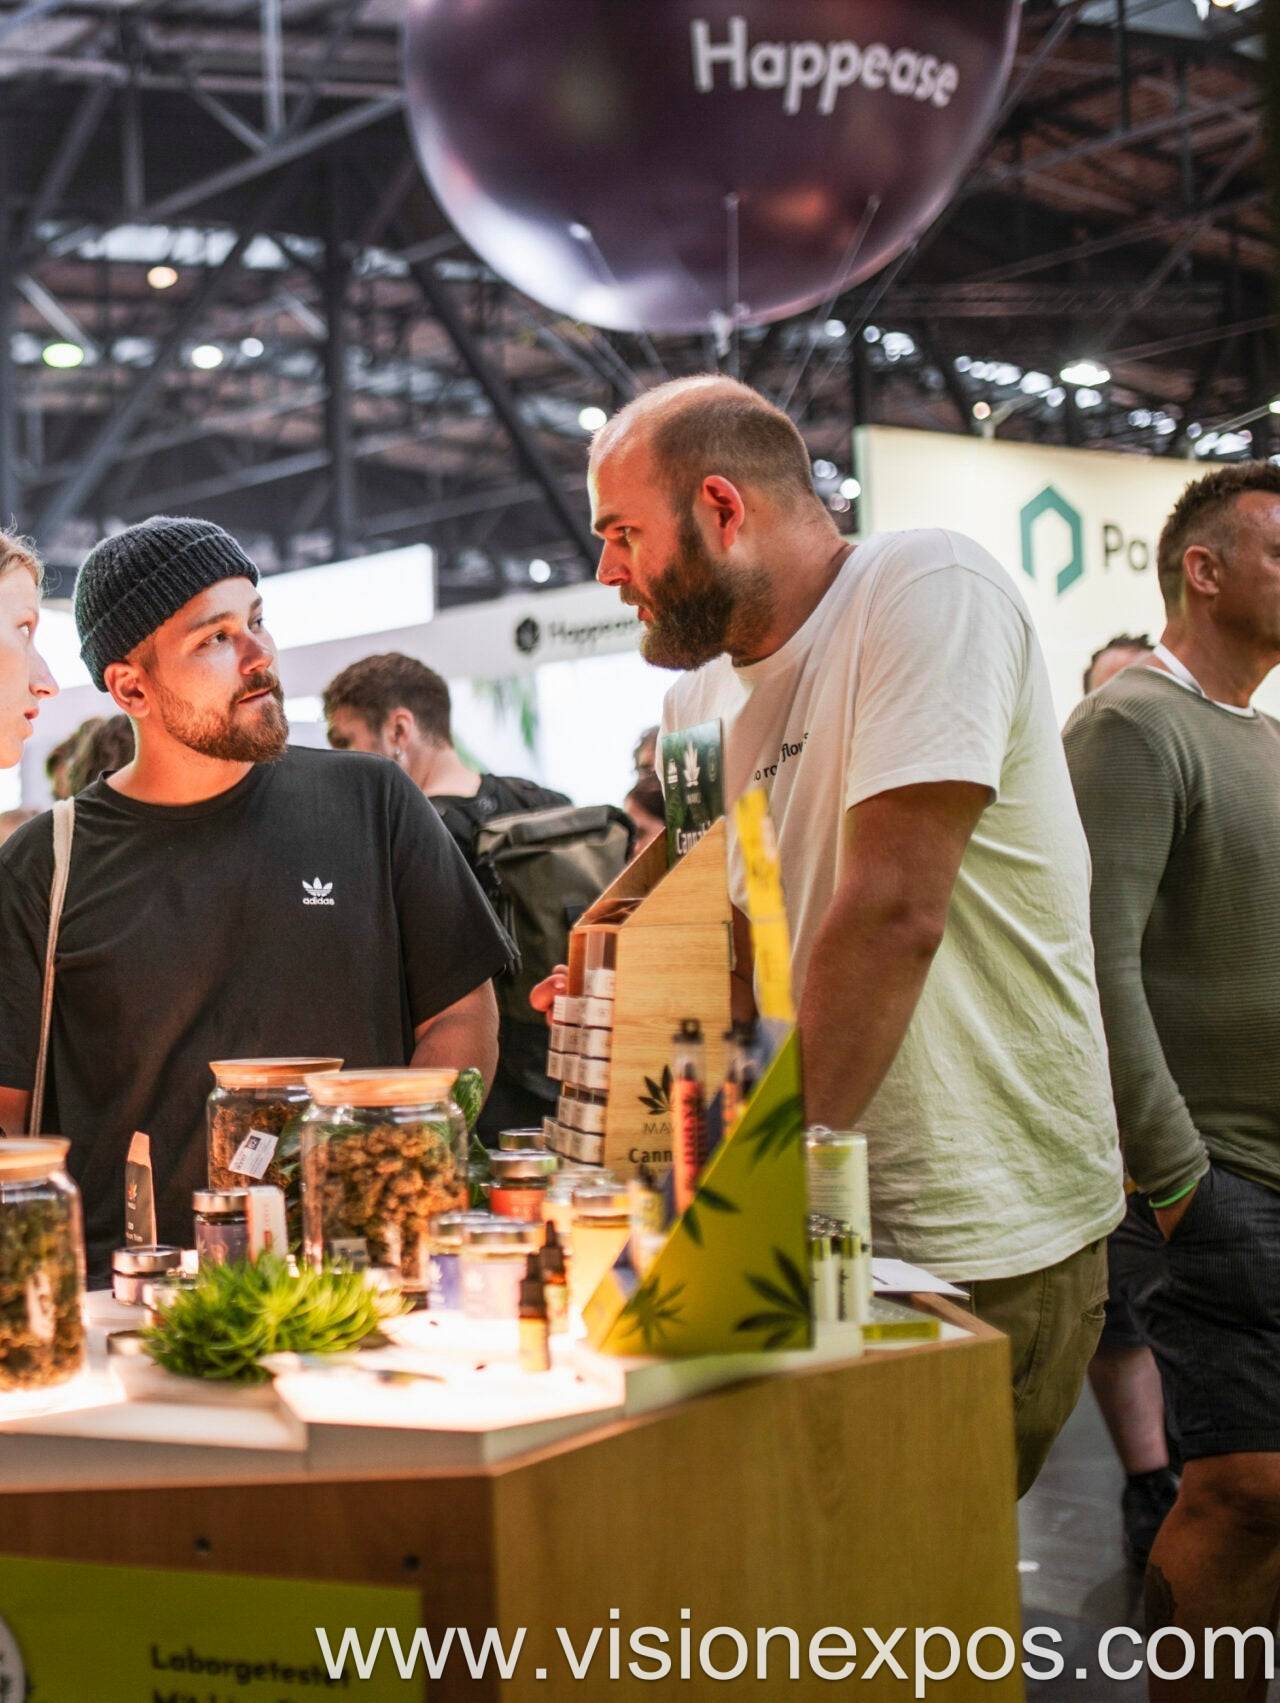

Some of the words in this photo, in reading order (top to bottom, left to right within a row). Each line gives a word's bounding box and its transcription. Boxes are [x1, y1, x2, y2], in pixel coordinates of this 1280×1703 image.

[690, 15, 960, 116] Happease
[1101, 523, 1149, 572] Po
[302, 896, 335, 906] adidas
[643, 1121, 673, 1135] MA
[628, 1148, 673, 1164] Cann
